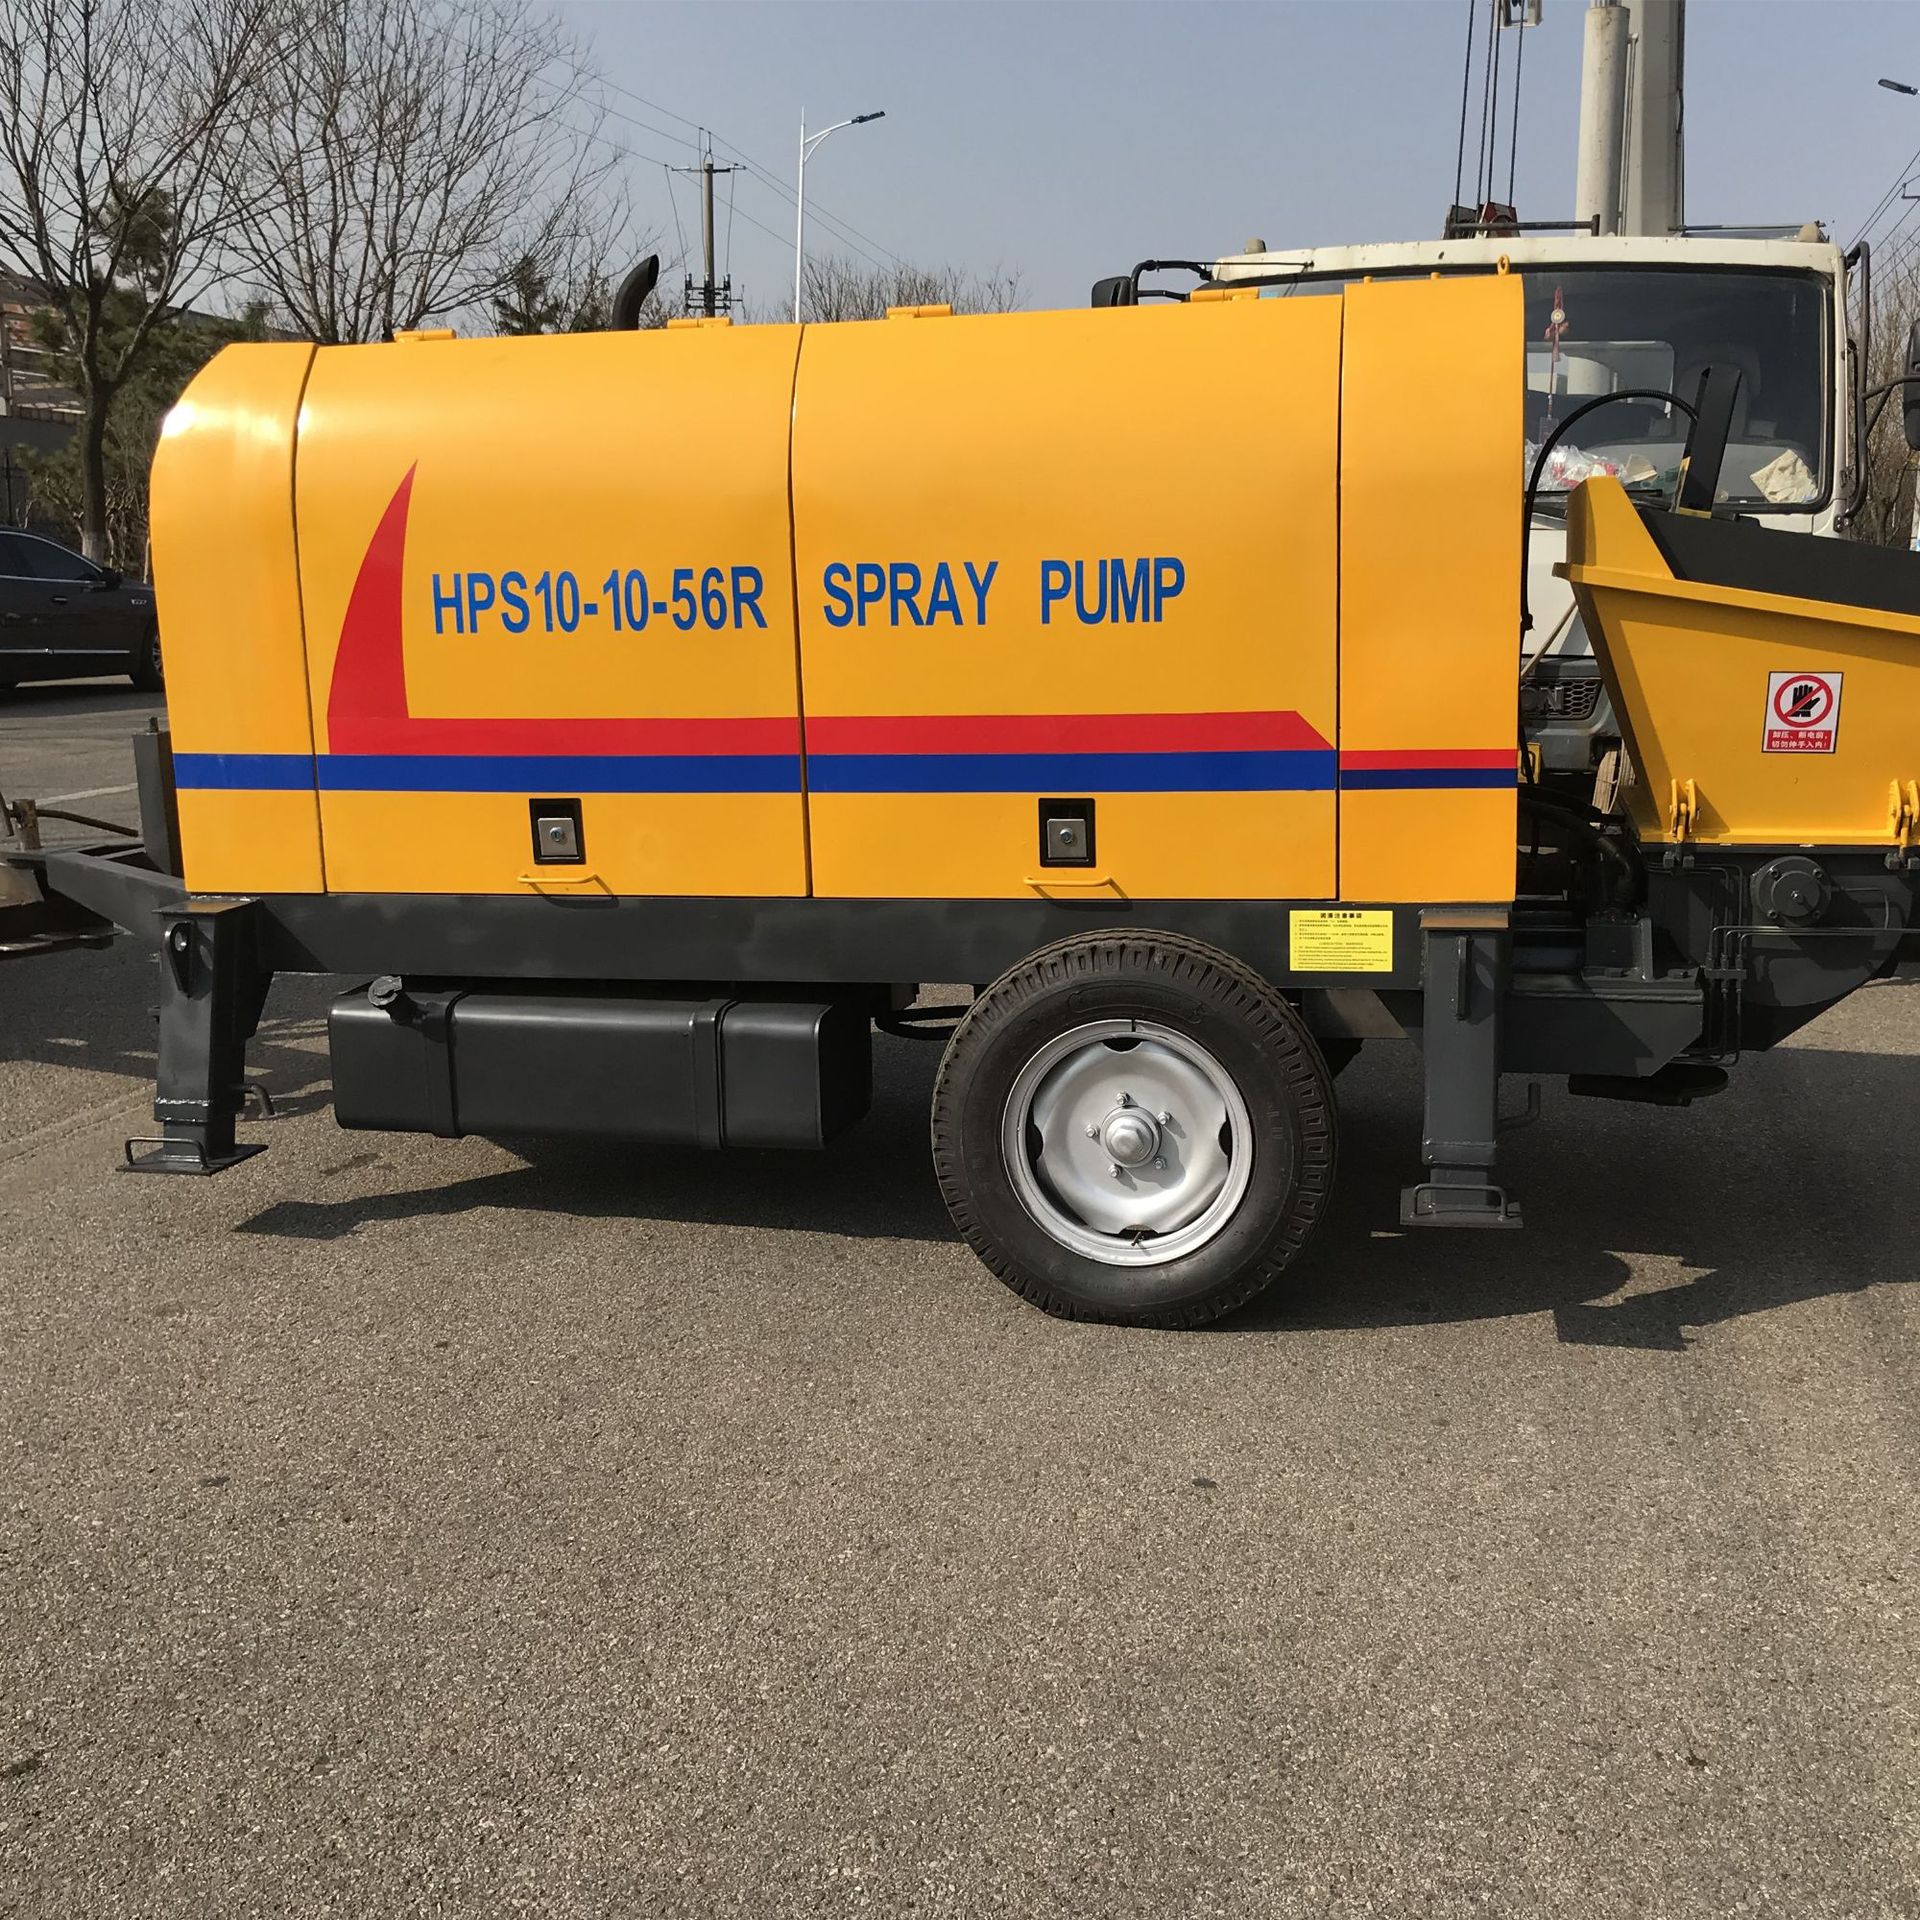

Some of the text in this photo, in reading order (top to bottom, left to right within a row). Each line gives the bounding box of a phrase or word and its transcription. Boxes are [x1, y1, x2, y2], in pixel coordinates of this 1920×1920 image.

[433, 557, 1186, 633] HPS10-10-56R SPRAY PUMP
